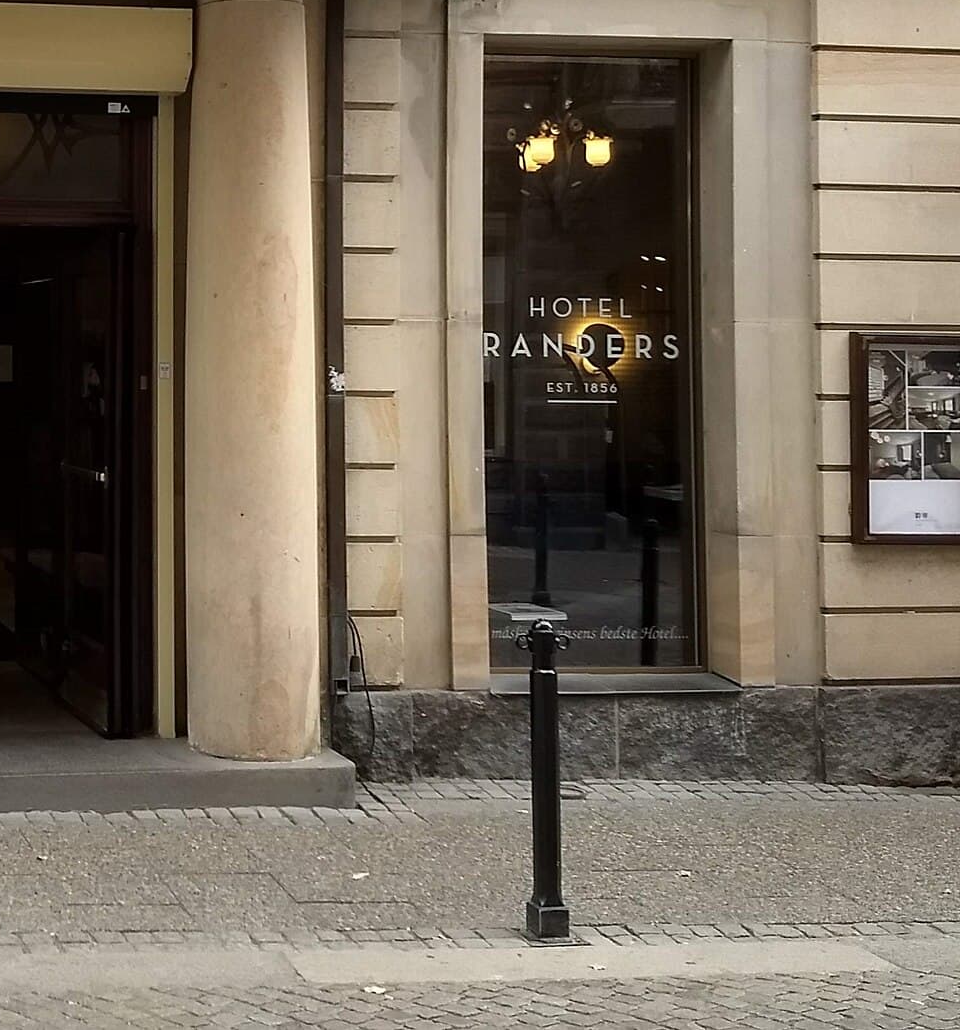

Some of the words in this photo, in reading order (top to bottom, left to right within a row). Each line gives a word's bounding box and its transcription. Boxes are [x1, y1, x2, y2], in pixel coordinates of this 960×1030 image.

[529, 296, 633, 319] HOTEL
[483, 332, 681, 360] RANDERS
[546, 382, 579, 394] EST.
[583, 382, 619, 394] 1856
[599, 625, 638, 640] bedste
